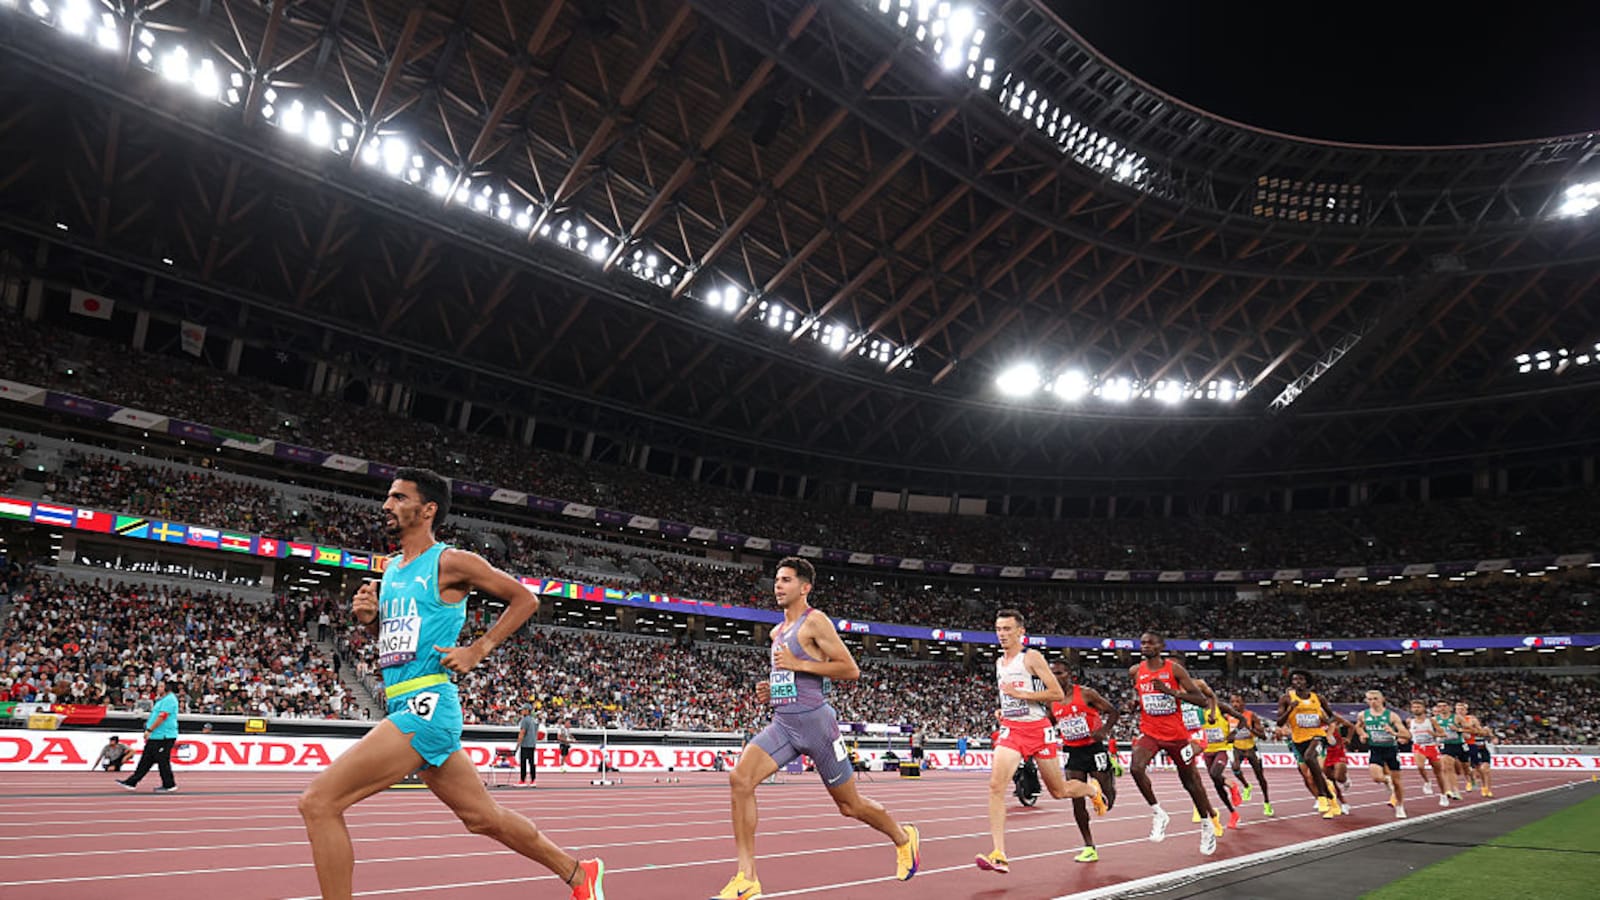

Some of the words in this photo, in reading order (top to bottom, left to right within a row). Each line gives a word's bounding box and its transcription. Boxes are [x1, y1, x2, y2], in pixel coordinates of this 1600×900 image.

[382, 617, 414, 633] TDK
[771, 671, 791, 683] TDK
[536, 748, 663, 767] HONDA
[1492, 757, 1584, 768] HONDA
